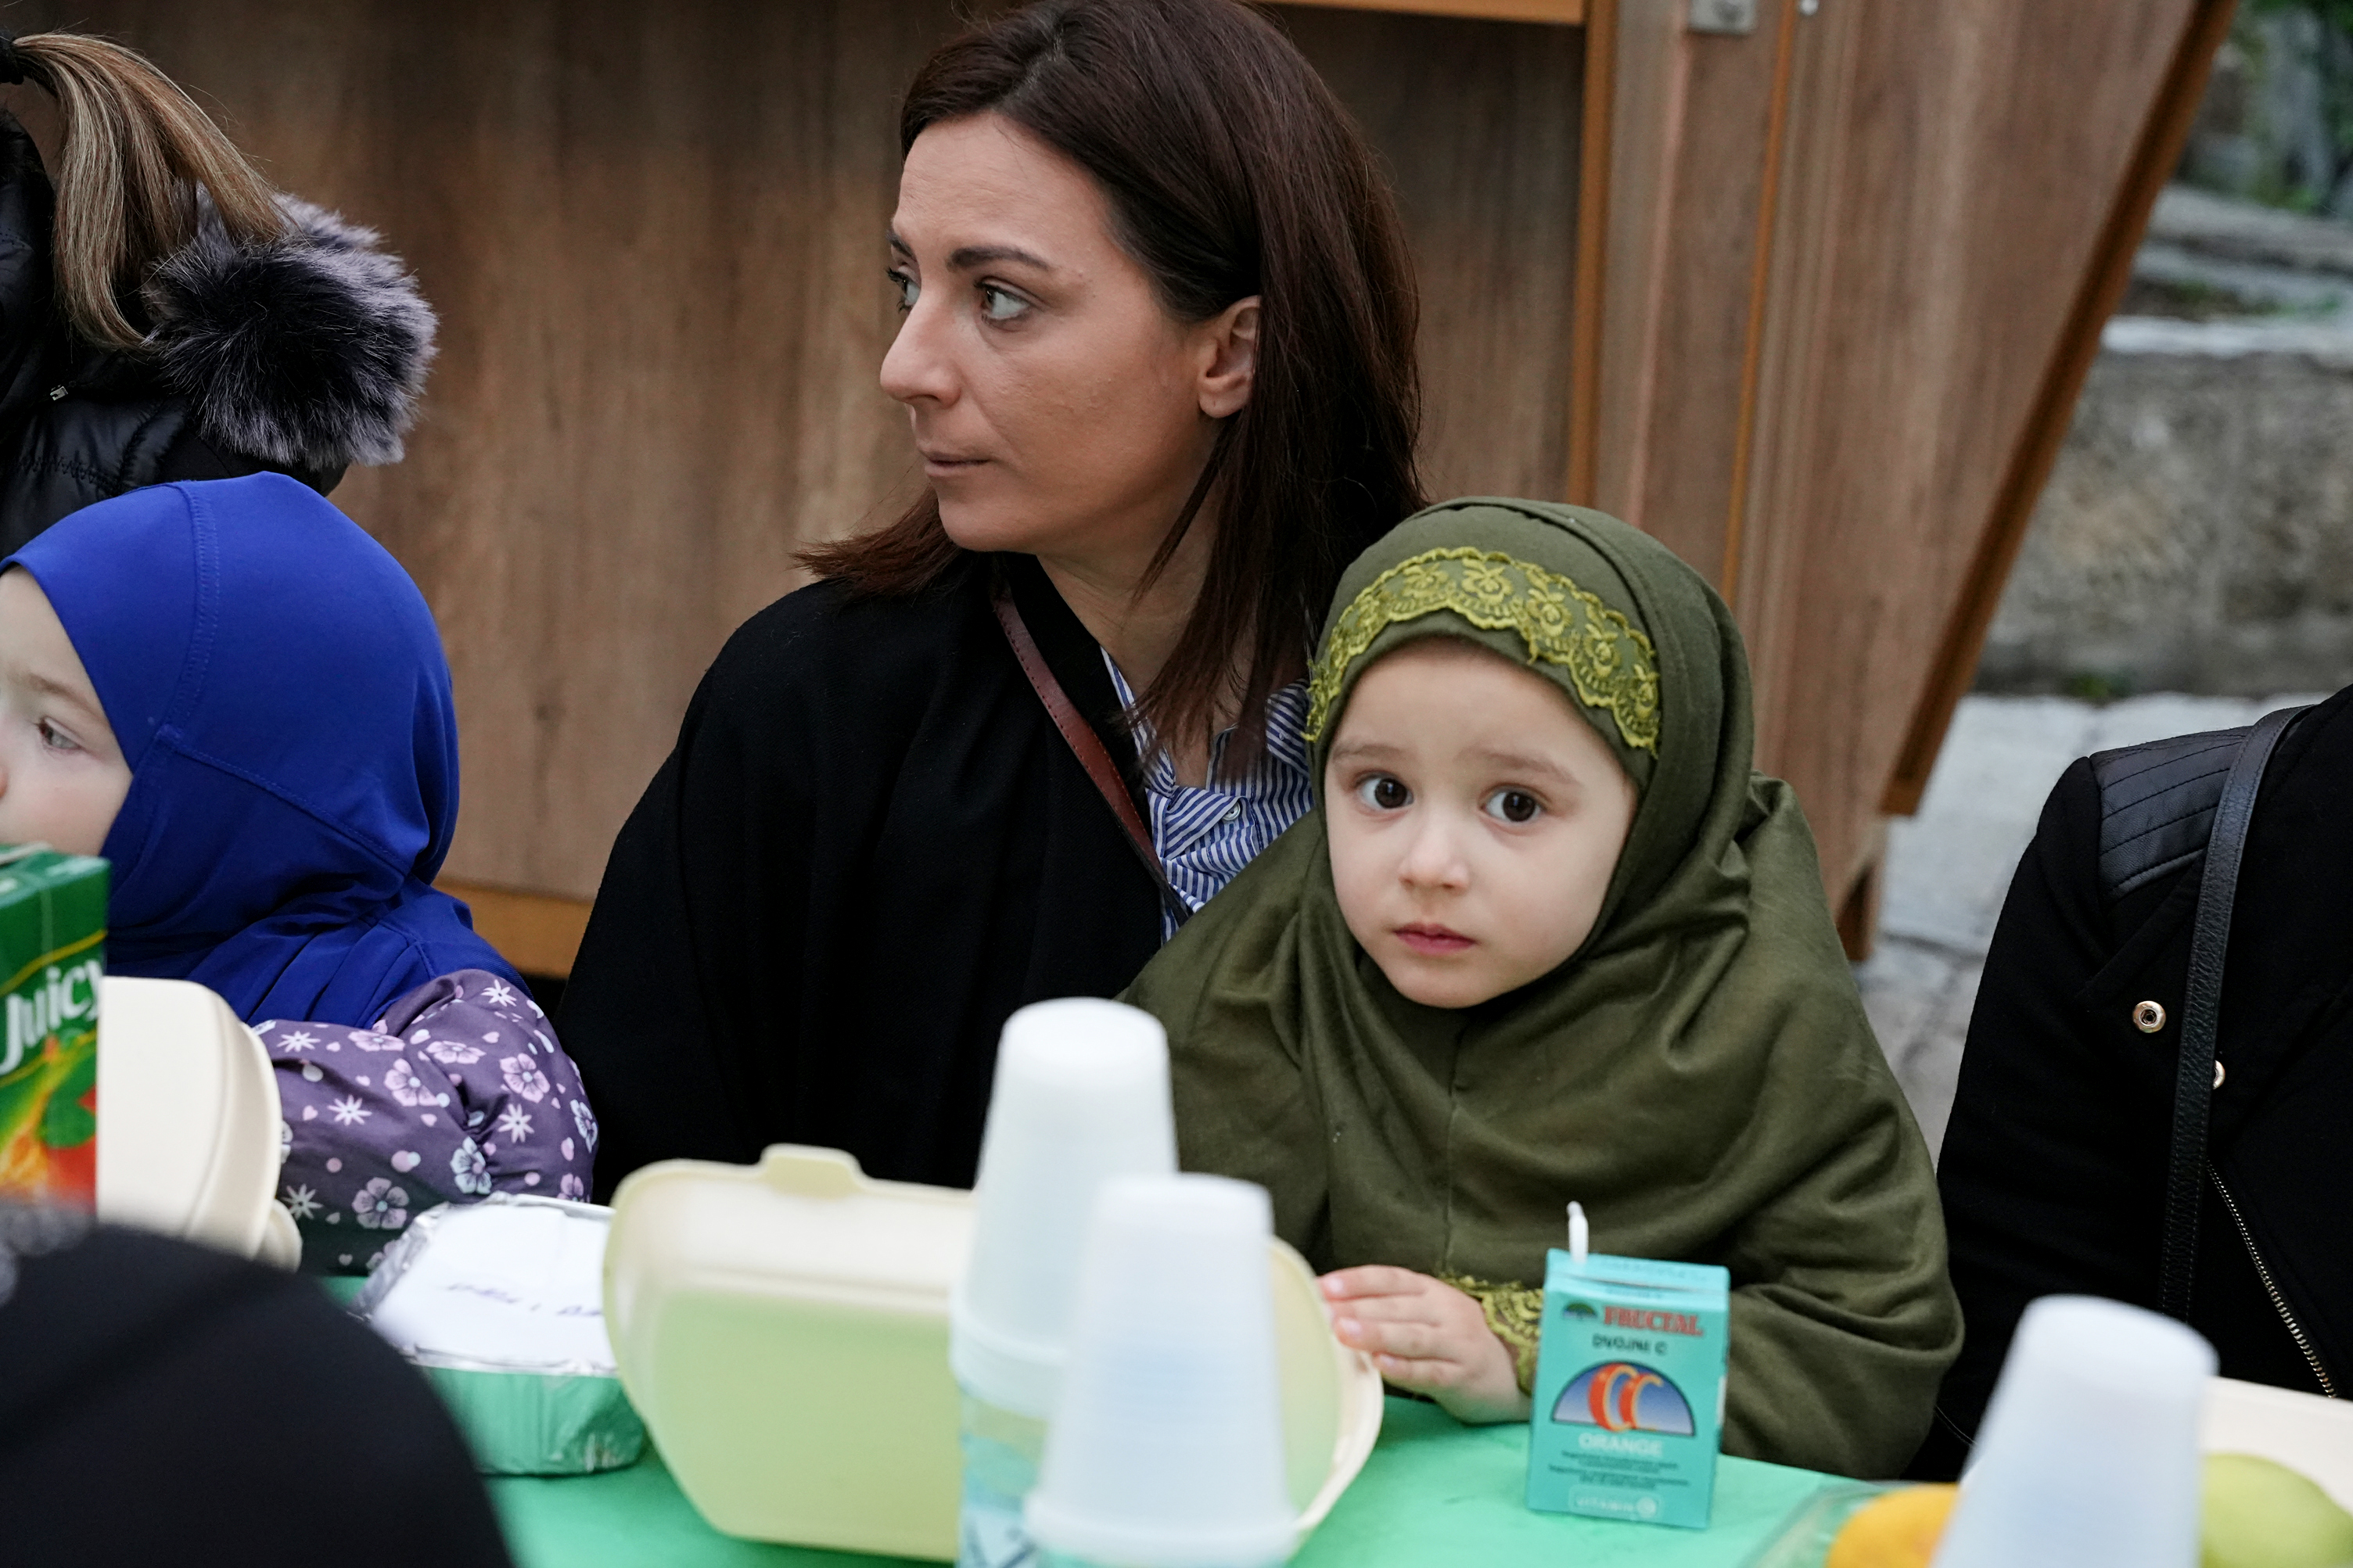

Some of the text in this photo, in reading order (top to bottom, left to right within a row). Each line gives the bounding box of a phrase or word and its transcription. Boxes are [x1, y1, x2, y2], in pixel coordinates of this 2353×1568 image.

[0, 960, 102, 1075] Juicy
[1604, 1305, 1704, 1337] FRUCTAL
[1592, 1333, 1650, 1353] DVOJNI
[1578, 1432, 1664, 1459] ORANGE
